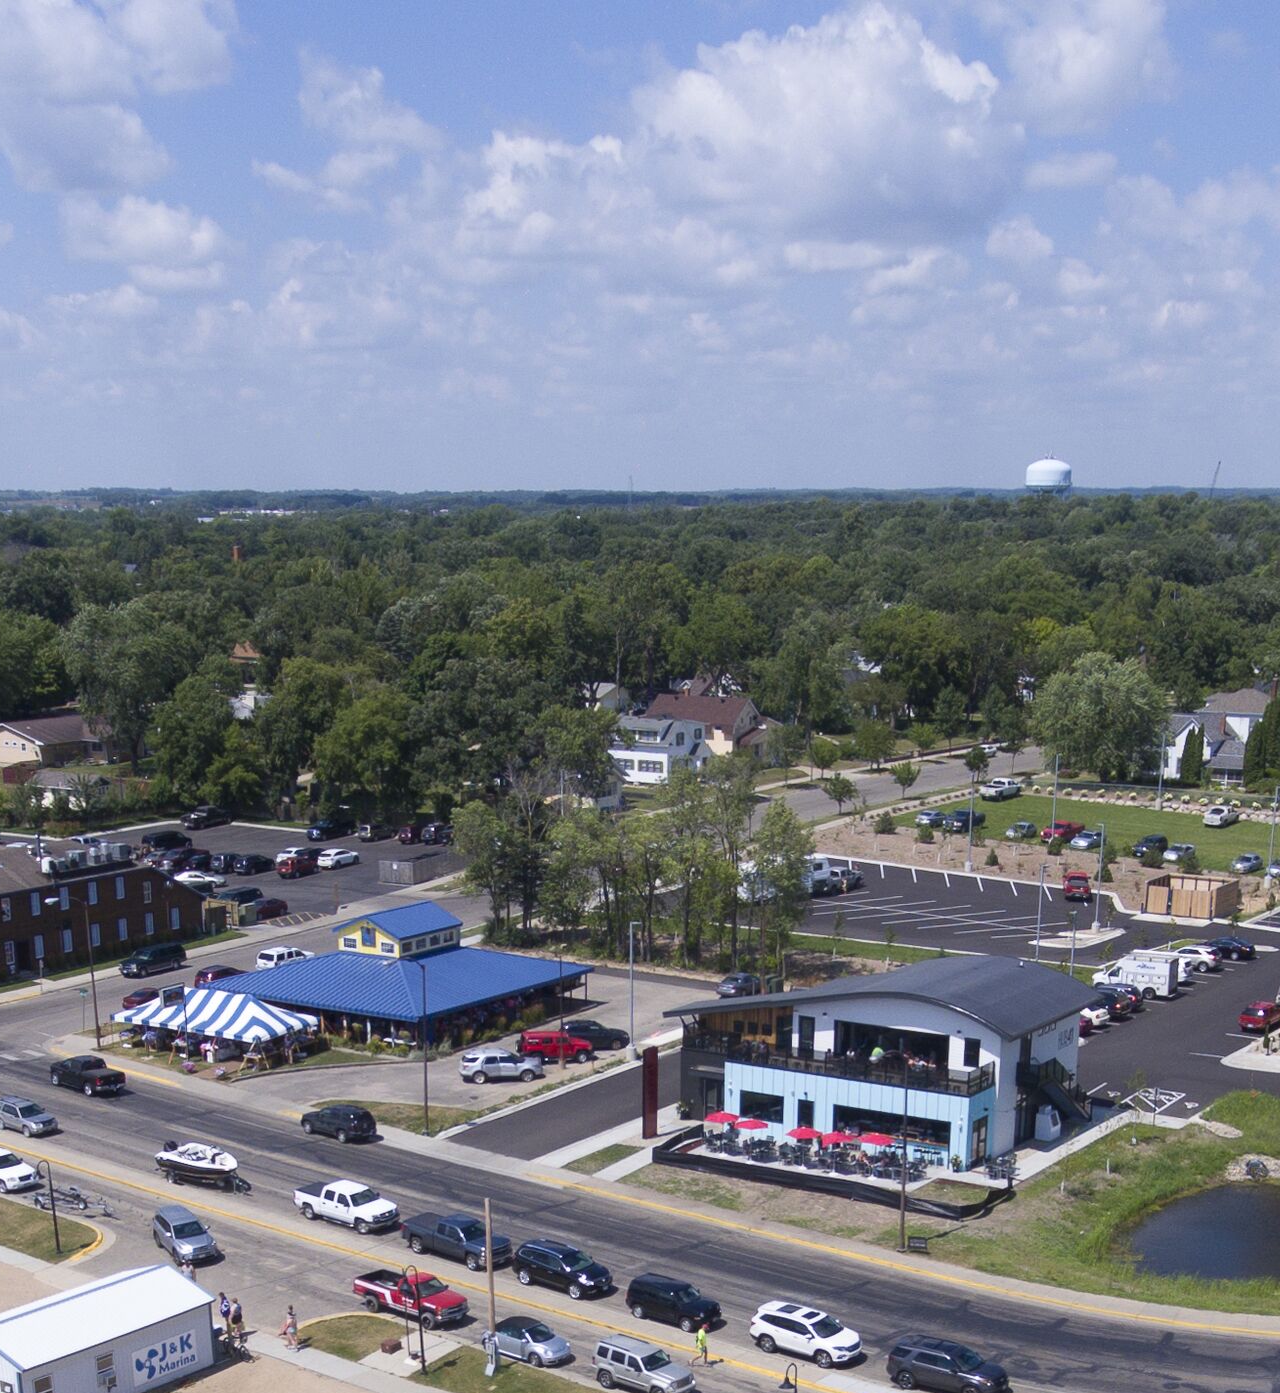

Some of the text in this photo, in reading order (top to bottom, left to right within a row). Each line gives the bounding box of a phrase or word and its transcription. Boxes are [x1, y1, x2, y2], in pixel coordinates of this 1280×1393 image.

[159, 1333, 193, 1362] J & K
[159, 1354, 196, 1374] Marina
